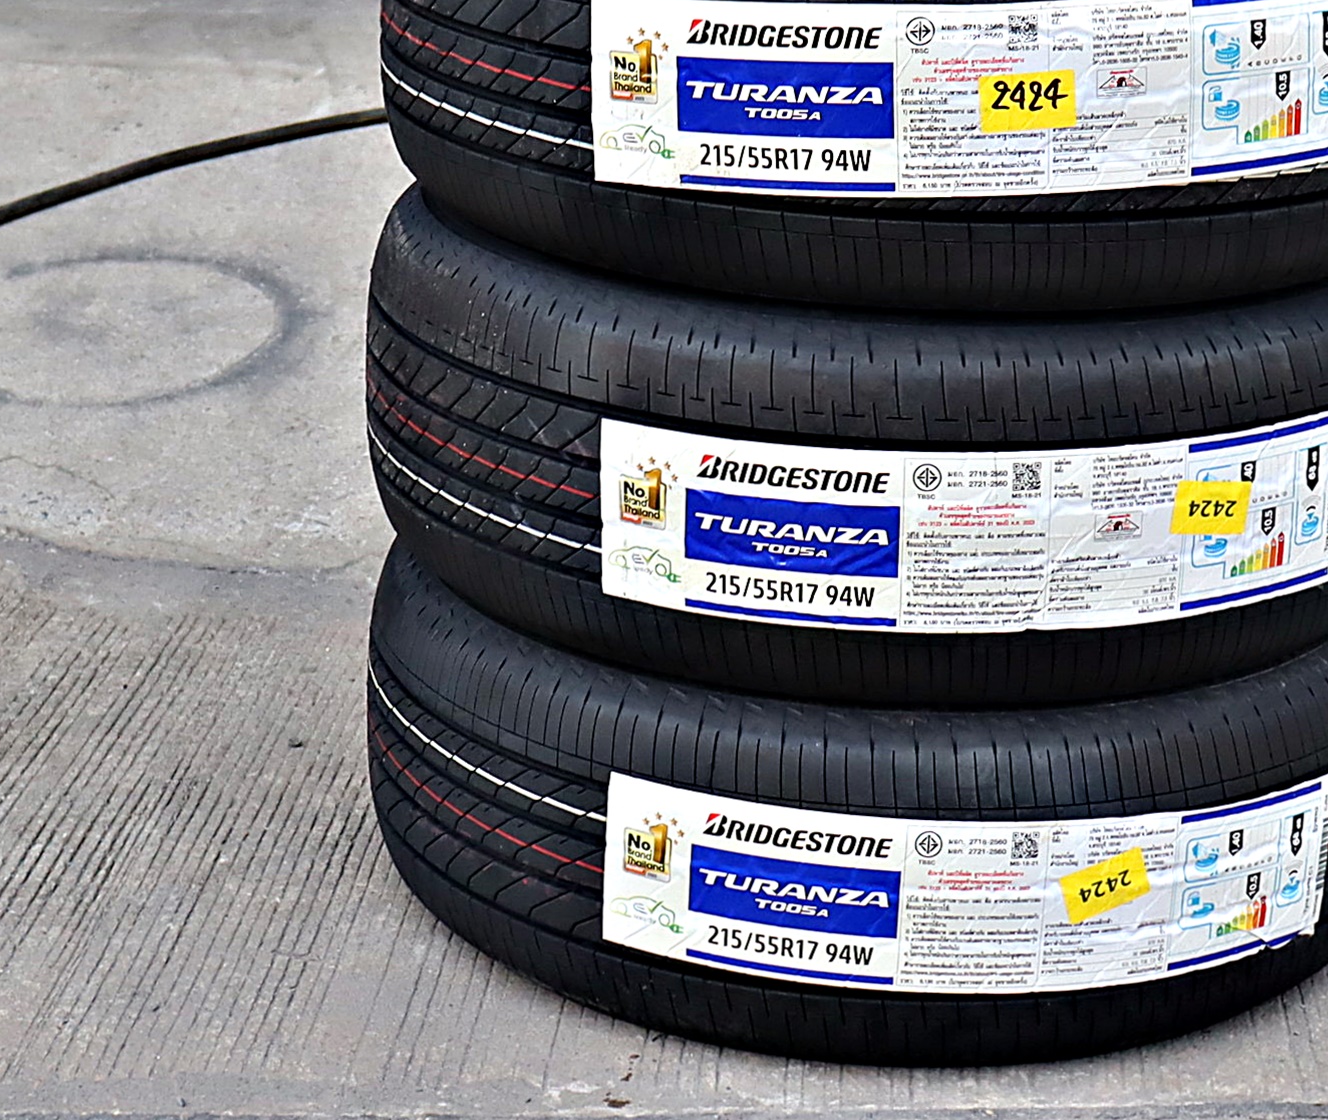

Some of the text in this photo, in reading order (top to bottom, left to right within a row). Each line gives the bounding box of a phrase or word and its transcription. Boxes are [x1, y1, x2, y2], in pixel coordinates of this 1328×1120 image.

[686, 19, 883, 50] BRIDGESTONE
[1253, 21, 1264, 48] 1.40
[613, 71, 639, 82] Brand
[613, 81, 652, 94] Thailand
[1278, 73, 1288, 101] 10.5
[685, 80, 884, 105] TURANZA
[990, 78, 1069, 112] 2424
[700, 142, 812, 171] 215/55R17
[821, 147, 872, 173] 94W
[696, 454, 891, 494] BRIDGESTONE
[623, 504, 661, 520] Thailand
[1188, 499, 1238, 518] 2424
[1264, 509, 1274, 533] 10.5
[694, 511, 889, 547] TURANZA
[705, 571, 875, 608] 215/55R17 94W
[703, 813, 893, 859] BRIDGESTONE
[627, 855, 666, 873] Thailand
[698, 868, 889, 909] TURANZA
[1078, 869, 1133, 904] 2424
[707, 925, 874, 967] 215/55R17 94W
